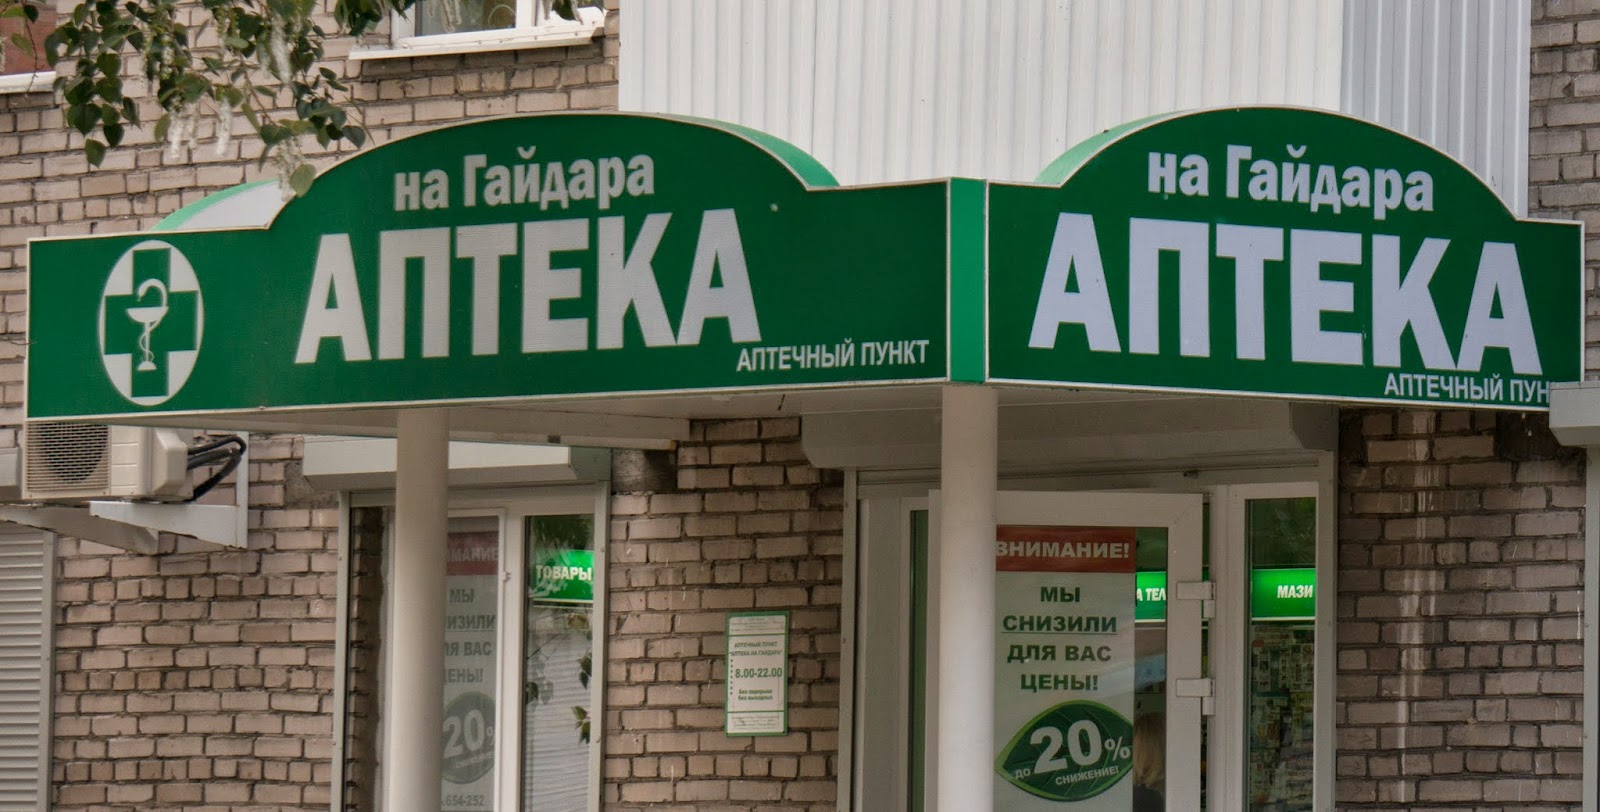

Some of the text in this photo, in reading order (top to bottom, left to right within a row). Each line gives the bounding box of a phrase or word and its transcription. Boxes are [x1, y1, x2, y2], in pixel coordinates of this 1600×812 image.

[394, 145, 655, 212] на Гайдара
[1148, 144, 1434, 220] на Гайдара
[295, 208, 761, 363] АПТЕКА
[1027, 212, 1543, 376] АПТЕКА
[736, 337, 930, 372] АПТЕЧНЫЙ ПУНКТ
[1384, 372, 1504, 400] АПТЕЧНЫЙ
[995, 541, 1130, 559] ВНИМАНИЕ!
[536, 565, 593, 581] ТОВАРЫ
[450, 588, 474, 603] МЫ
[1040, 587, 1081, 602] МЫ
[1277, 585, 1314, 599] МАЗИ
[1003, 615, 1117, 632] СНИЗИЛИ
[464, 641, 492, 657] ВАС
[1007, 645, 1112, 663] ДЛЯ ВАС
[735, 667, 783, 679] 8.00-22.00
[1021, 673, 1099, 693] ЦЕНЫ!
[1055, 765, 1120, 786] СНИЖЕНИЕ!
